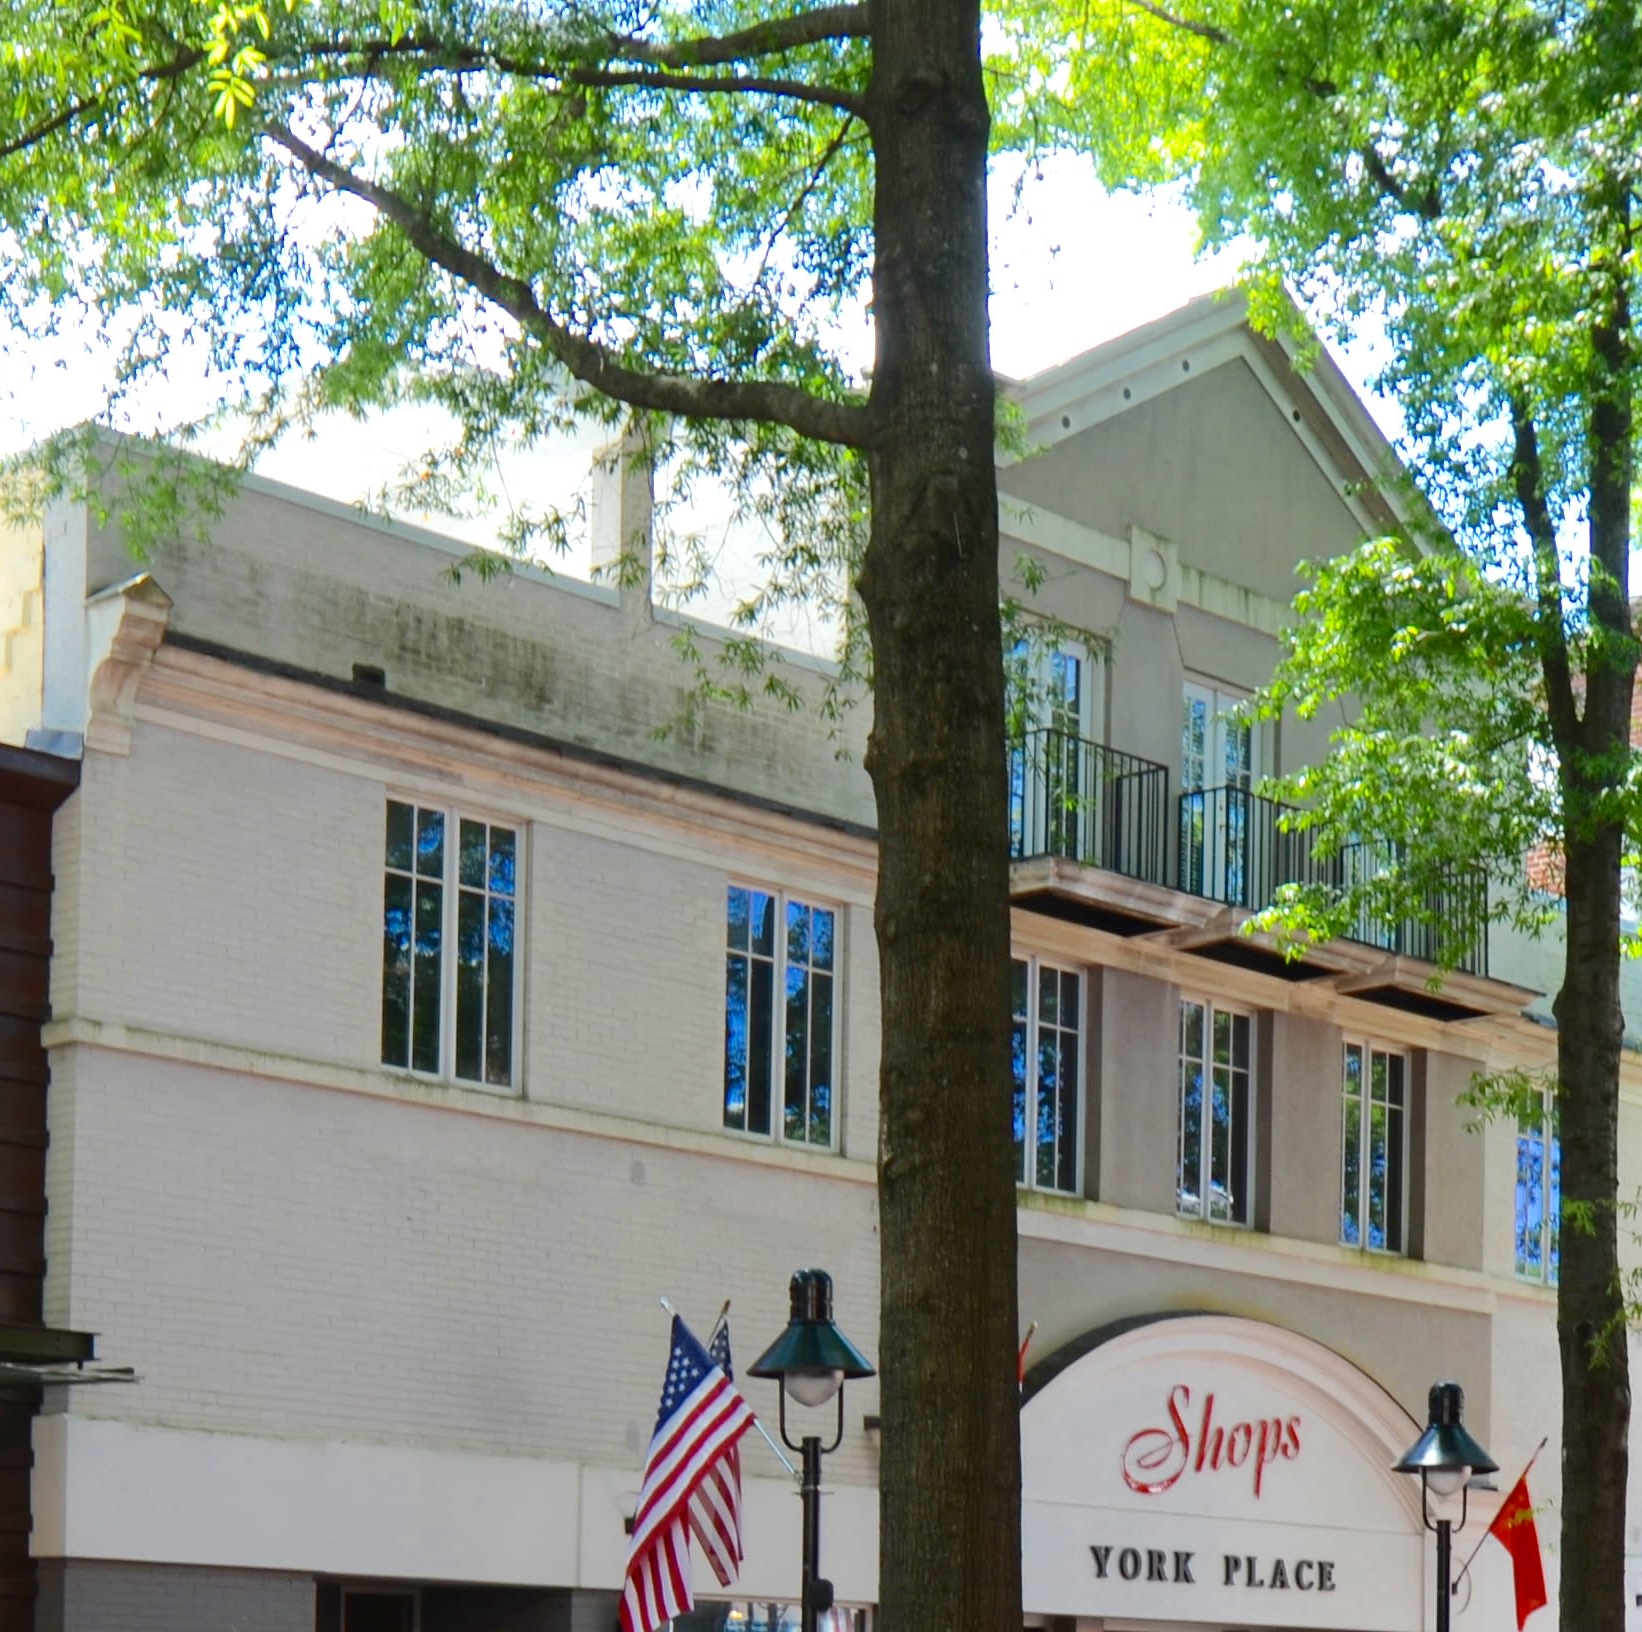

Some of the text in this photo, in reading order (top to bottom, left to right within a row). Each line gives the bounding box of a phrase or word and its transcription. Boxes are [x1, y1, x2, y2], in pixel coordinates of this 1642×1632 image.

[1120, 1384, 1302, 1500] Shops
[1090, 1545, 1337, 1592] YORK PLACE
